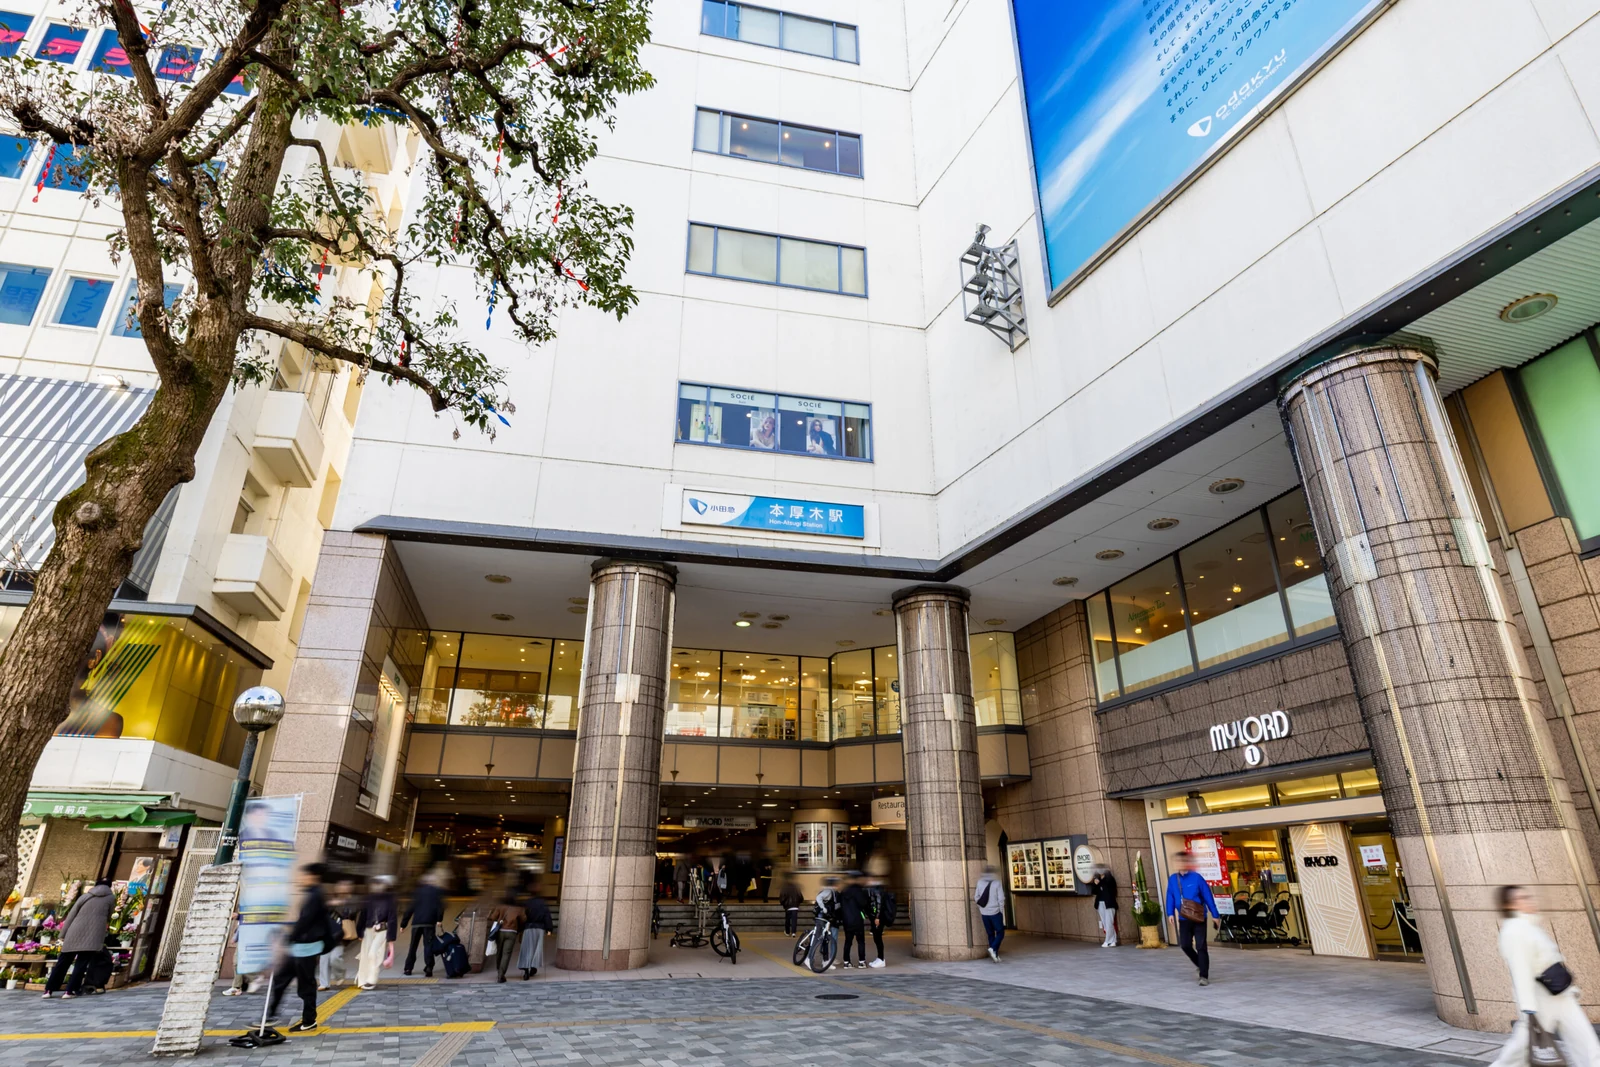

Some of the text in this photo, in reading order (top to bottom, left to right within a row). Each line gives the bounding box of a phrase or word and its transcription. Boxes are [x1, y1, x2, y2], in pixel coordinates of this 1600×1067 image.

[1231, 56, 1288, 113] DEVELOPMENT
[710, 505, 736, 514] 小田急
[769, 503, 843, 523] 本厚木駅
[769, 518, 823, 529] Hon-Atsugi Station
[1210, 711, 1291, 751] MYLORD
[52, 804, 88, 815] 駅前店
